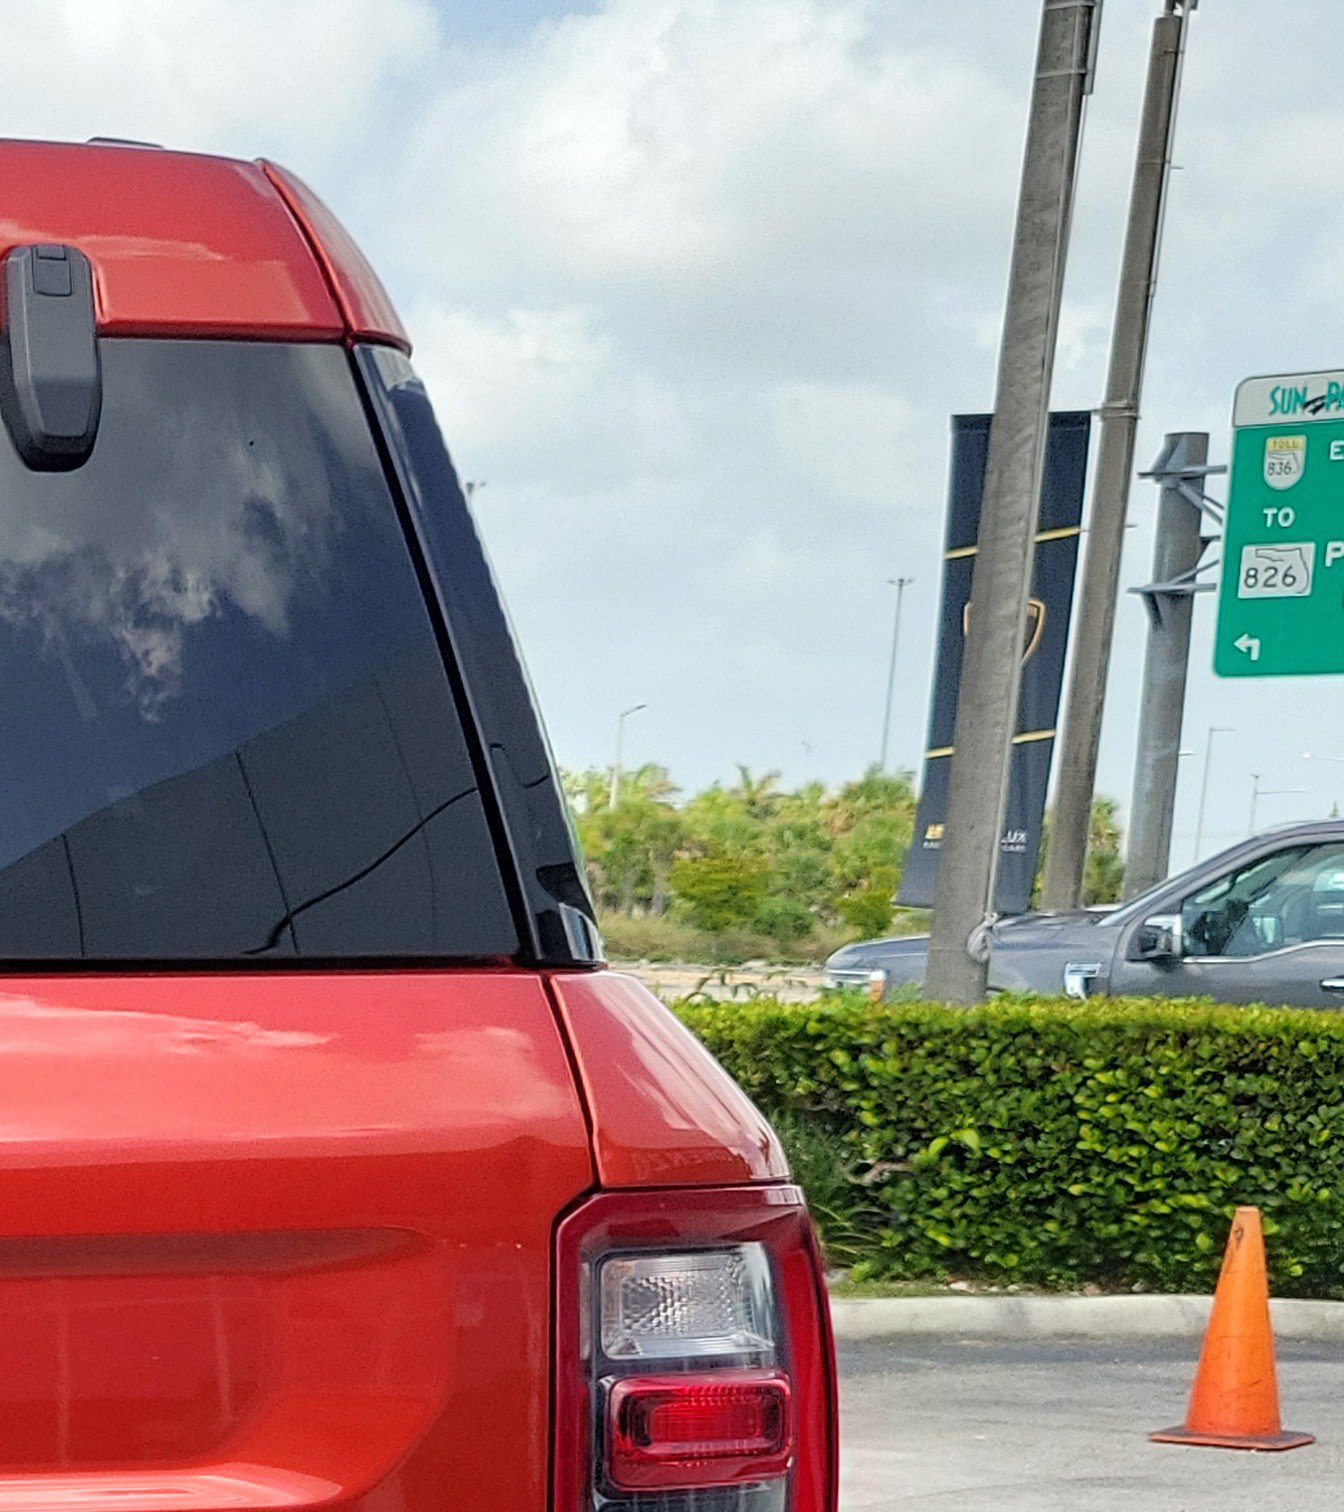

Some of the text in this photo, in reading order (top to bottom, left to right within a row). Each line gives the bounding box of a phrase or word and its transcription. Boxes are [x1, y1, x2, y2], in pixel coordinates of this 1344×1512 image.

[1268, 385, 1308, 416] SUN
[1267, 461, 1292, 477] 836
[1263, 507, 1296, 529] TO
[1244, 564, 1297, 589] 826
